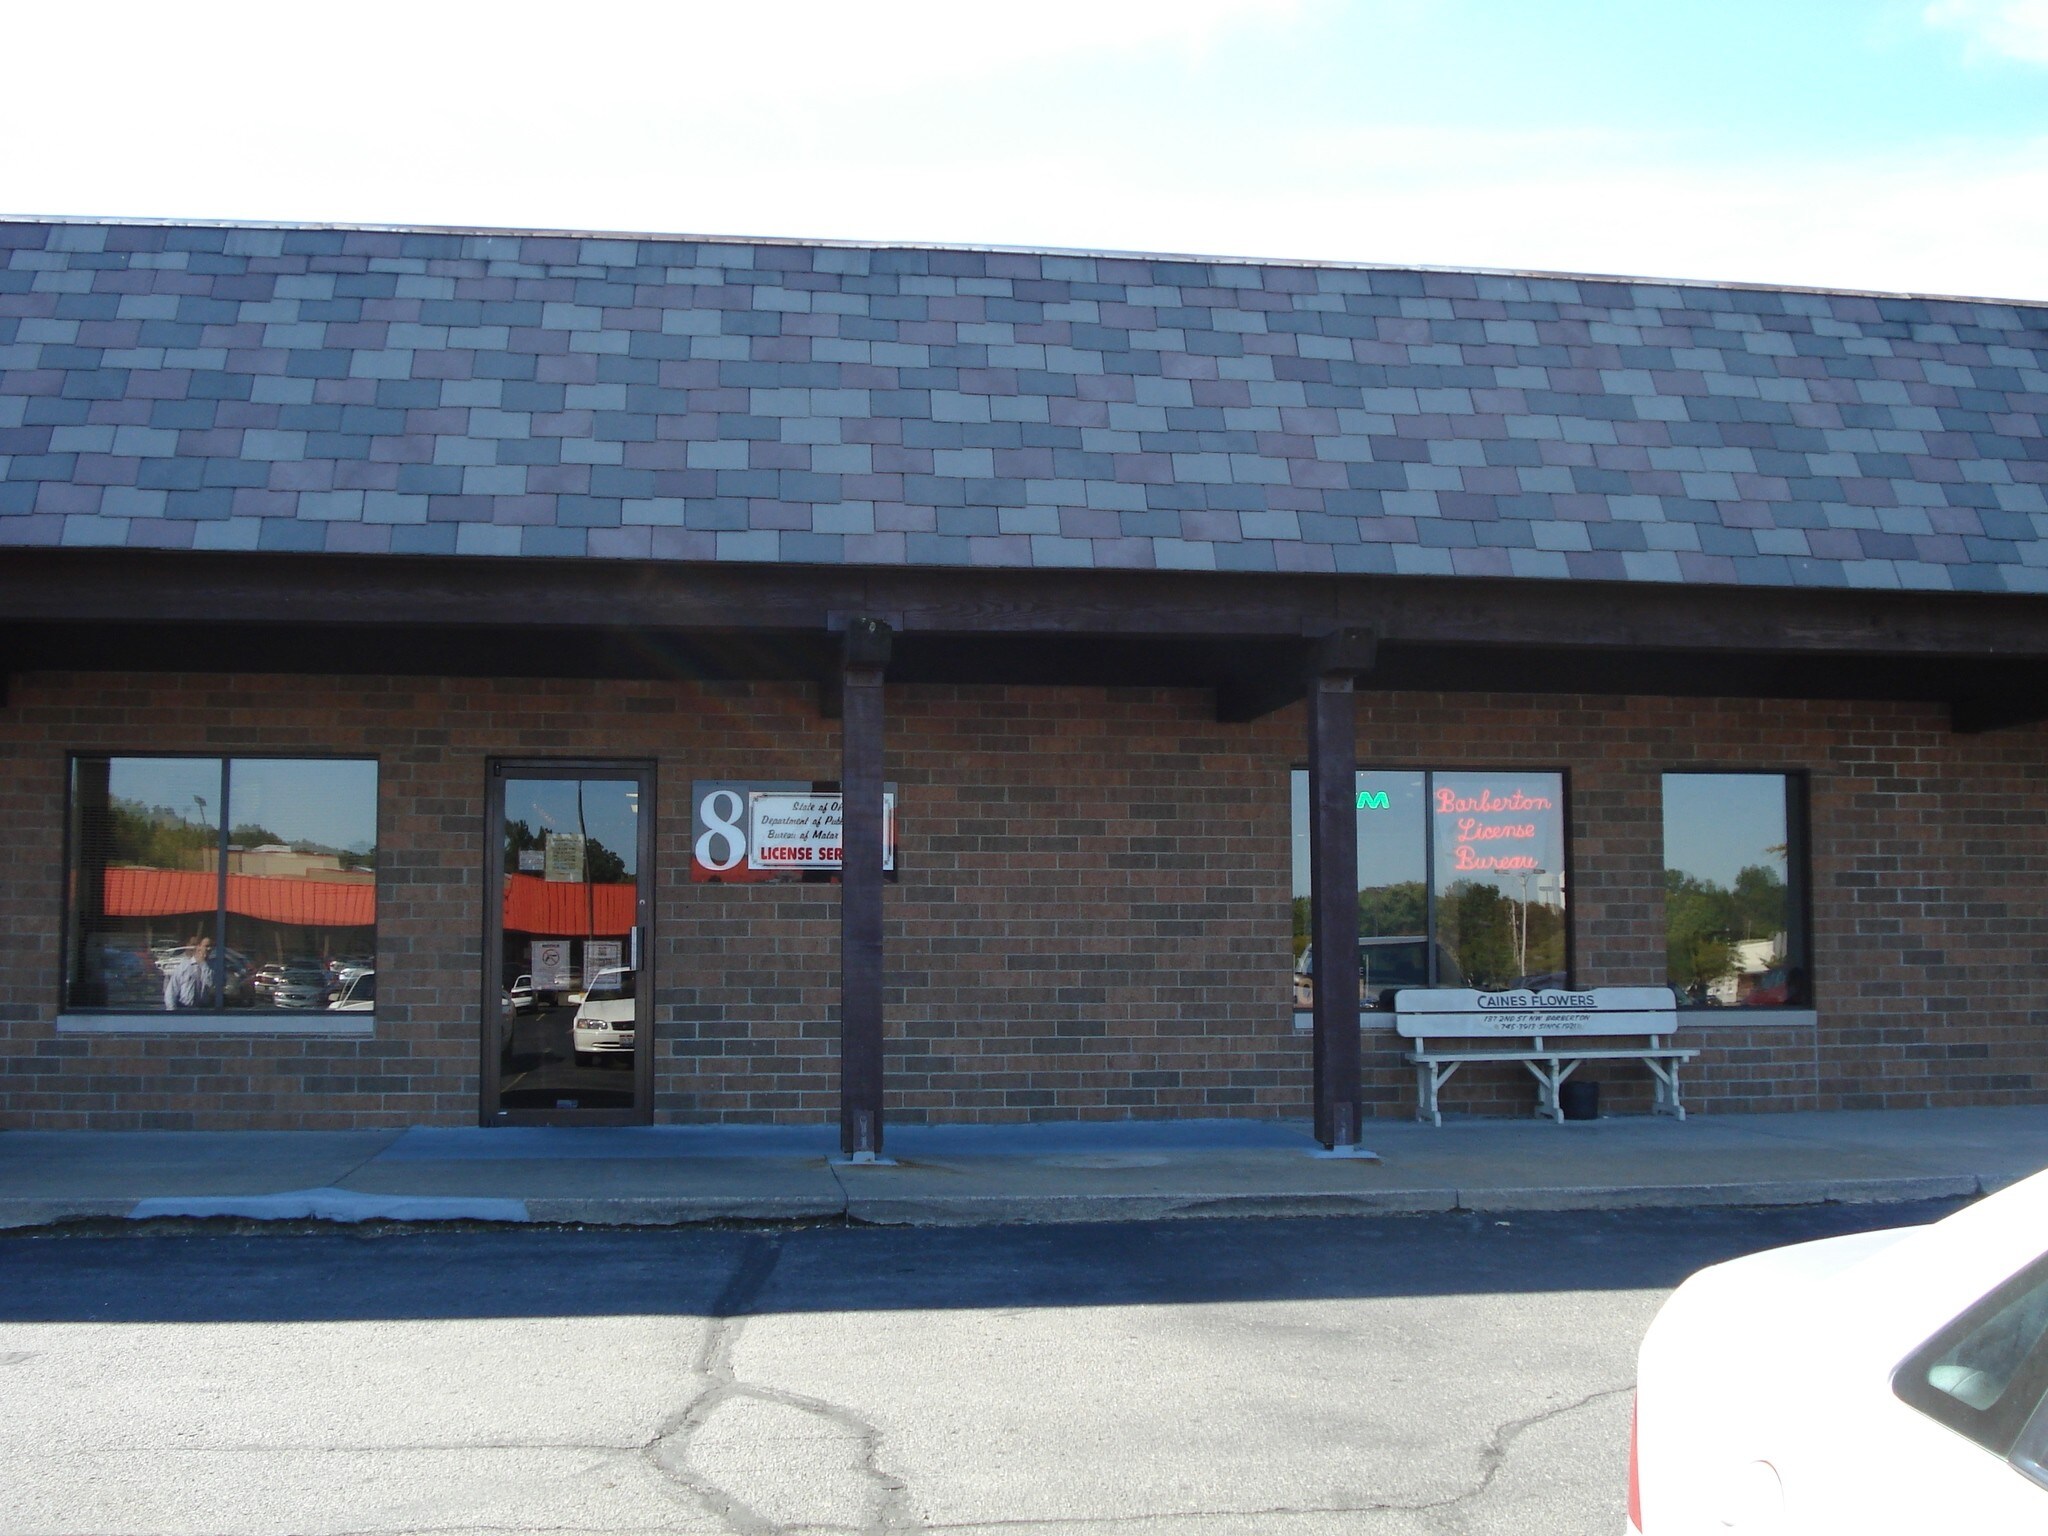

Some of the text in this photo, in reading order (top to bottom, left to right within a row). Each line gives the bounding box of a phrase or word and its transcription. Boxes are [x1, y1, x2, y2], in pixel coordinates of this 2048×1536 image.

[792, 801, 815, 811] State
[818, 802, 829, 814] of
[1435, 788, 1552, 813] Barberton
[761, 815, 809, 826] Department
[812, 817, 822, 828] of
[695, 790, 746, 870] 8
[767, 830, 839, 841] Bureau of Motor
[1457, 817, 1536, 842] License
[760, 847, 844, 861] LICENSE SER
[1455, 845, 1538, 871] Bureau
[1477, 995, 1595, 1009] CAINES FLOWERS
